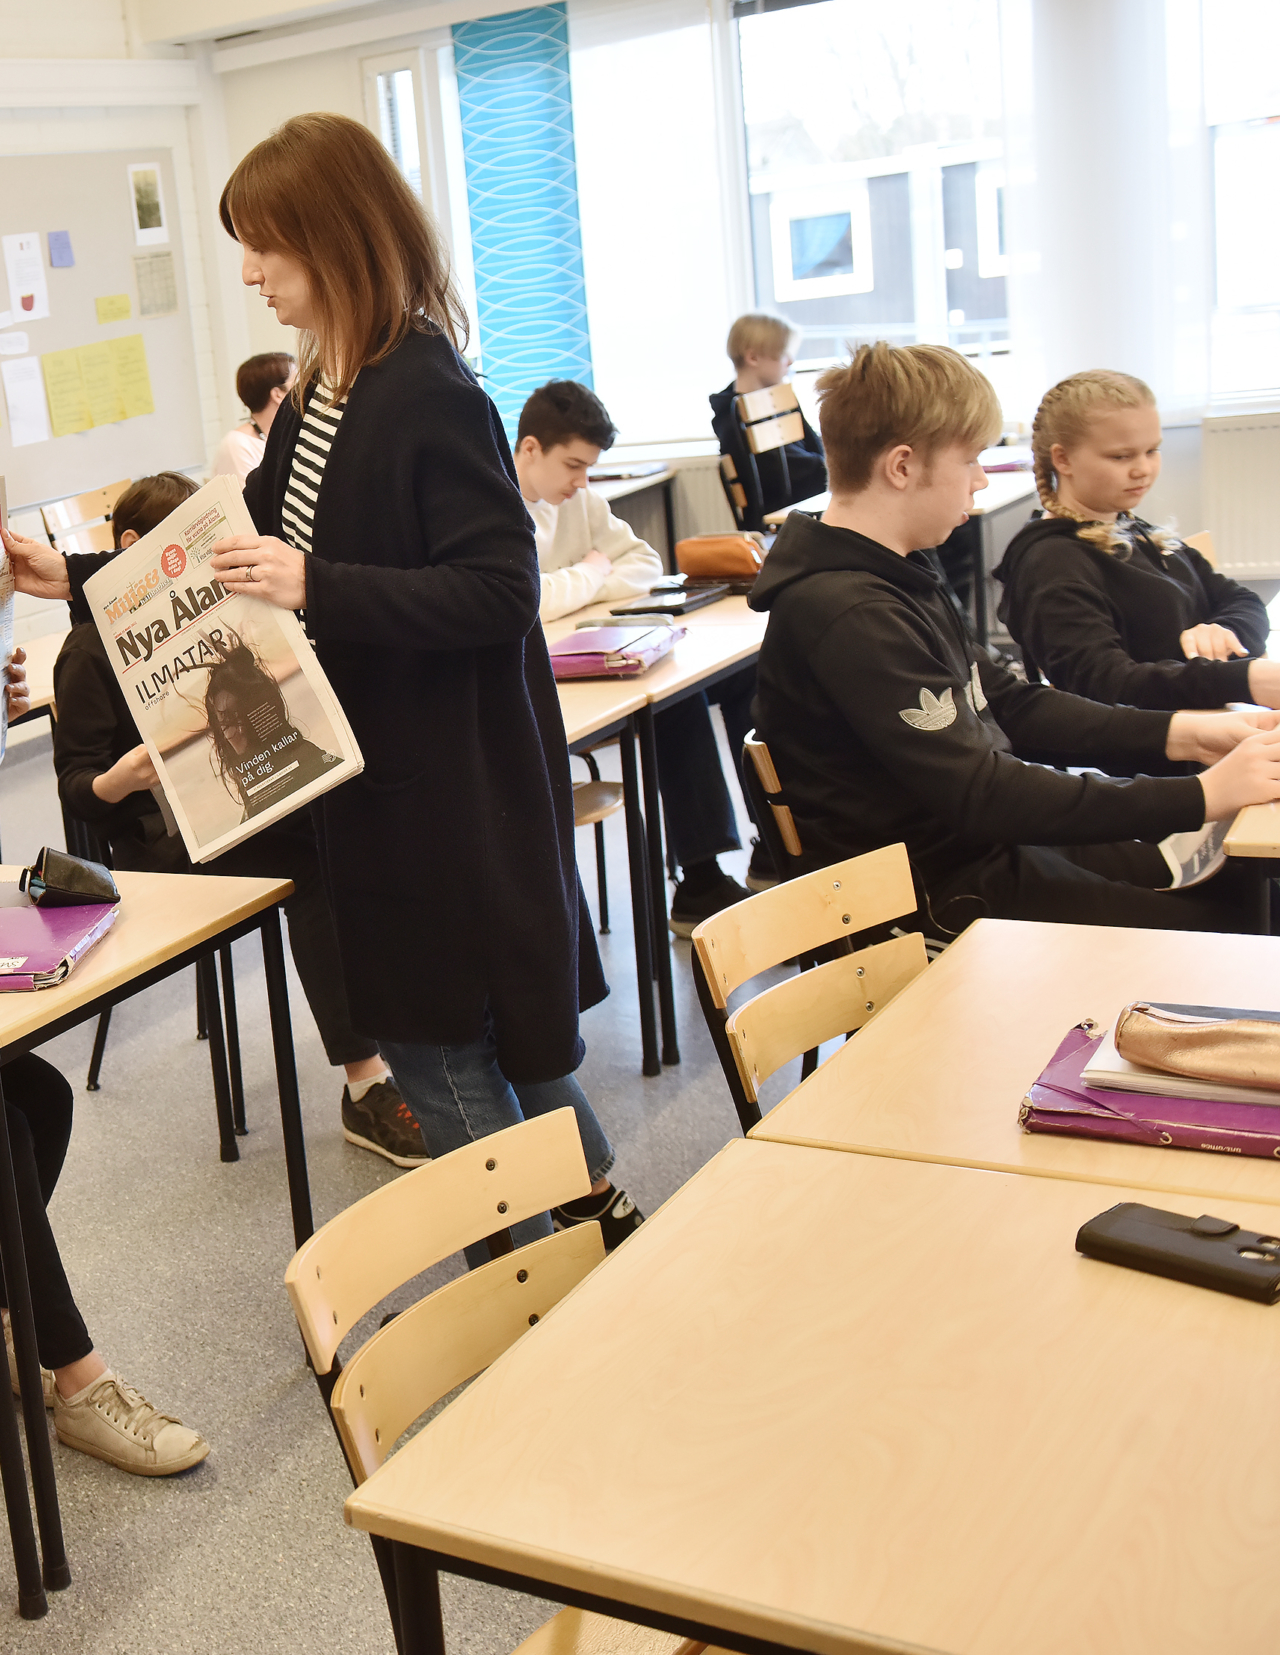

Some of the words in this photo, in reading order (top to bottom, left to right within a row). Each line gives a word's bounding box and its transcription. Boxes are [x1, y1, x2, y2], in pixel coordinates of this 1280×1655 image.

[115, 618, 171, 667] Nya
[169, 577, 233, 631] Ålan
[135, 628, 228, 704] ILMATAR
[144, 690, 170, 711] offshore
[235, 749, 271, 775] Vinden
[271, 731, 298, 752] kallar
[241, 772, 255, 788] på
[256, 761, 275, 776] dig.
